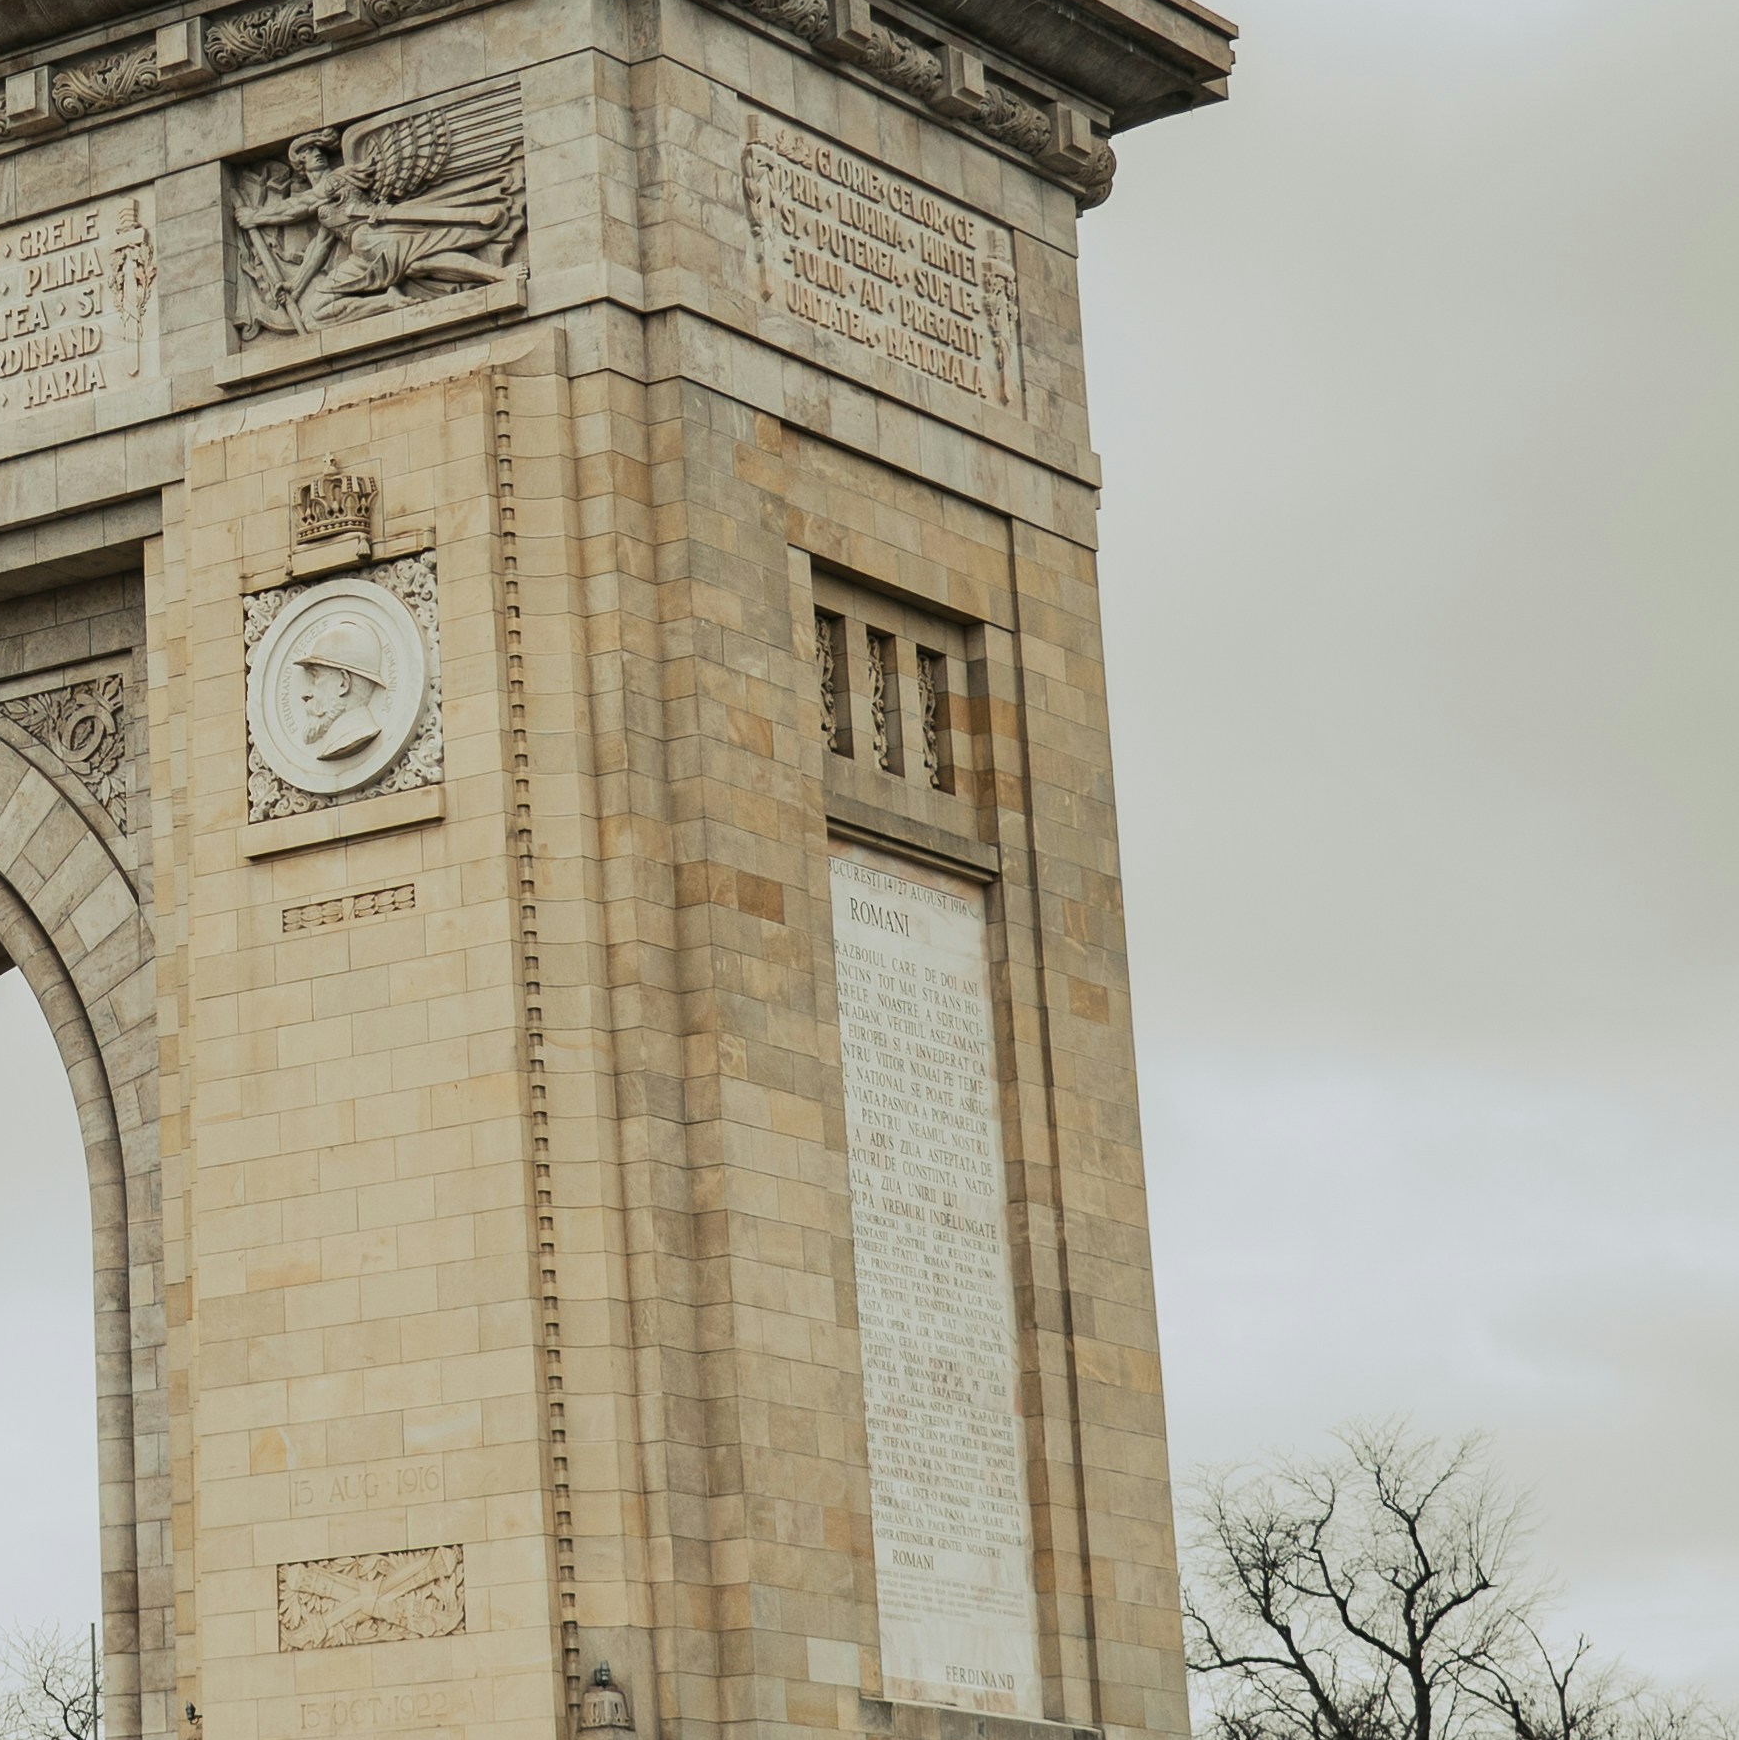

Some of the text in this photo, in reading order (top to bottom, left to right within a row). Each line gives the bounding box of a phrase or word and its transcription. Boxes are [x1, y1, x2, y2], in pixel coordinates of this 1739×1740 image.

[816, 145, 975, 249] GLORIE CELOR CE
[18, 210, 99, 260] GRELE
[779, 166, 978, 286] PRIN LUMINA MINTEI
[781, 203, 799, 239] SI
[816, 219, 902, 287] PUTEREA
[25, 247, 102, 296] PLINA
[77, 285, 101, 318] SI
[859, 276, 883, 314] AU
[900, 295, 983, 360] PREGATIT
[786, 280, 986, 399] UNITATEA NATIONALA
[23, 359, 106, 409] MARIA
[849, 896, 910, 937] ROMANI
[909, 886, 947, 909] AUGUST
[949, 899, 967, 916] 1916
[834, 938, 979, 997] RAZBOIUL CARE DE DOI ANI
[836, 961, 871, 983] INCINS
[877, 972, 895, 991] TOT
[898, 979, 916, 998] MAI
[921, 986, 961, 1009] STRANS
[850, 1005, 986, 1056] ADANC VECHIUL ASEZAMANT
[876, 992, 919, 1018] NOASTRE
[924, 1008, 932, 1022] A
[847, 1022, 986, 1077] EUROPEI SI A INVEDERAT CA
[875, 1050, 905, 1072] VIITOR
[909, 1060, 940, 1083] NUMAI
[942, 1069, 954, 1087] PE
[851, 1084, 988, 1136] VIATA PASNICA A POPOARELOR
[855, 1065, 905, 1093] NATIONAL
[909, 1081, 921, 1098] SE
[924, 1085, 954, 1107] POATE
[853, 1127, 993, 1178] A ADUS ZIUA ASTEPTATA DE
[861, 1106, 989, 1157] PENTRU NEAMUL NOSTRU
[879, 1175, 902, 1195] ZIUA
[883, 1154, 896, 1172] DE
[901, 1160, 958, 1188] CONSTIINTA
[881, 1196, 925, 1221] VREMURI
[928, 1209, 997, 1239] INDELUNGATE
[294, 1465, 440, 1506] 15 AUG 1916
[891, 1548, 934, 1570] ROMANI
[945, 1665, 1014, 1690] FERDINAND
[300, 1703, 320, 1729] 15
[394, 1691, 447, 1722] 1922
